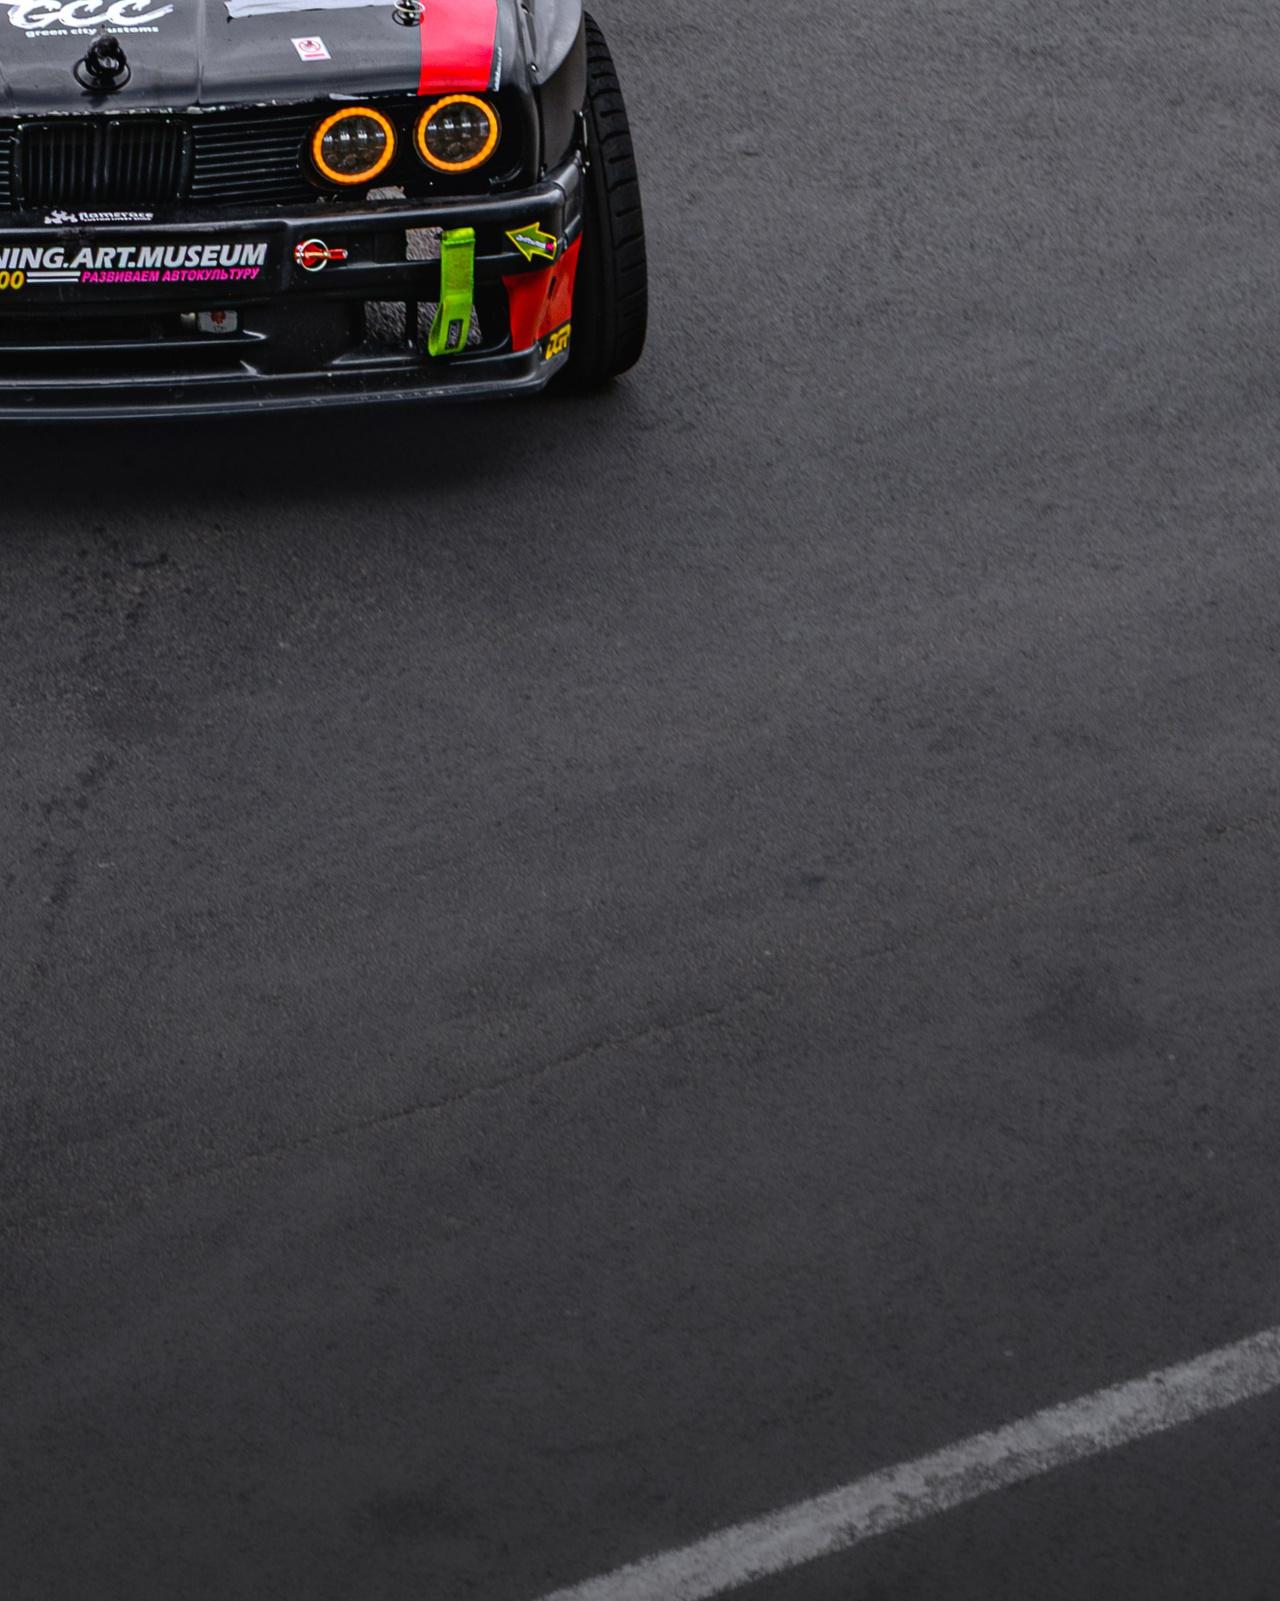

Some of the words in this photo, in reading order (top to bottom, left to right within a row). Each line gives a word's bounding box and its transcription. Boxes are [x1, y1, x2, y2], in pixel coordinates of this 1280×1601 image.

[25, 27, 68, 38] green
[70, 26, 97, 36] city
[102, 25, 160, 34] ustoms
[81, 270, 160, 284] РАЗВИВАЕМ
[161, 266, 260, 282] АВТОКУЛЬТУРУ
